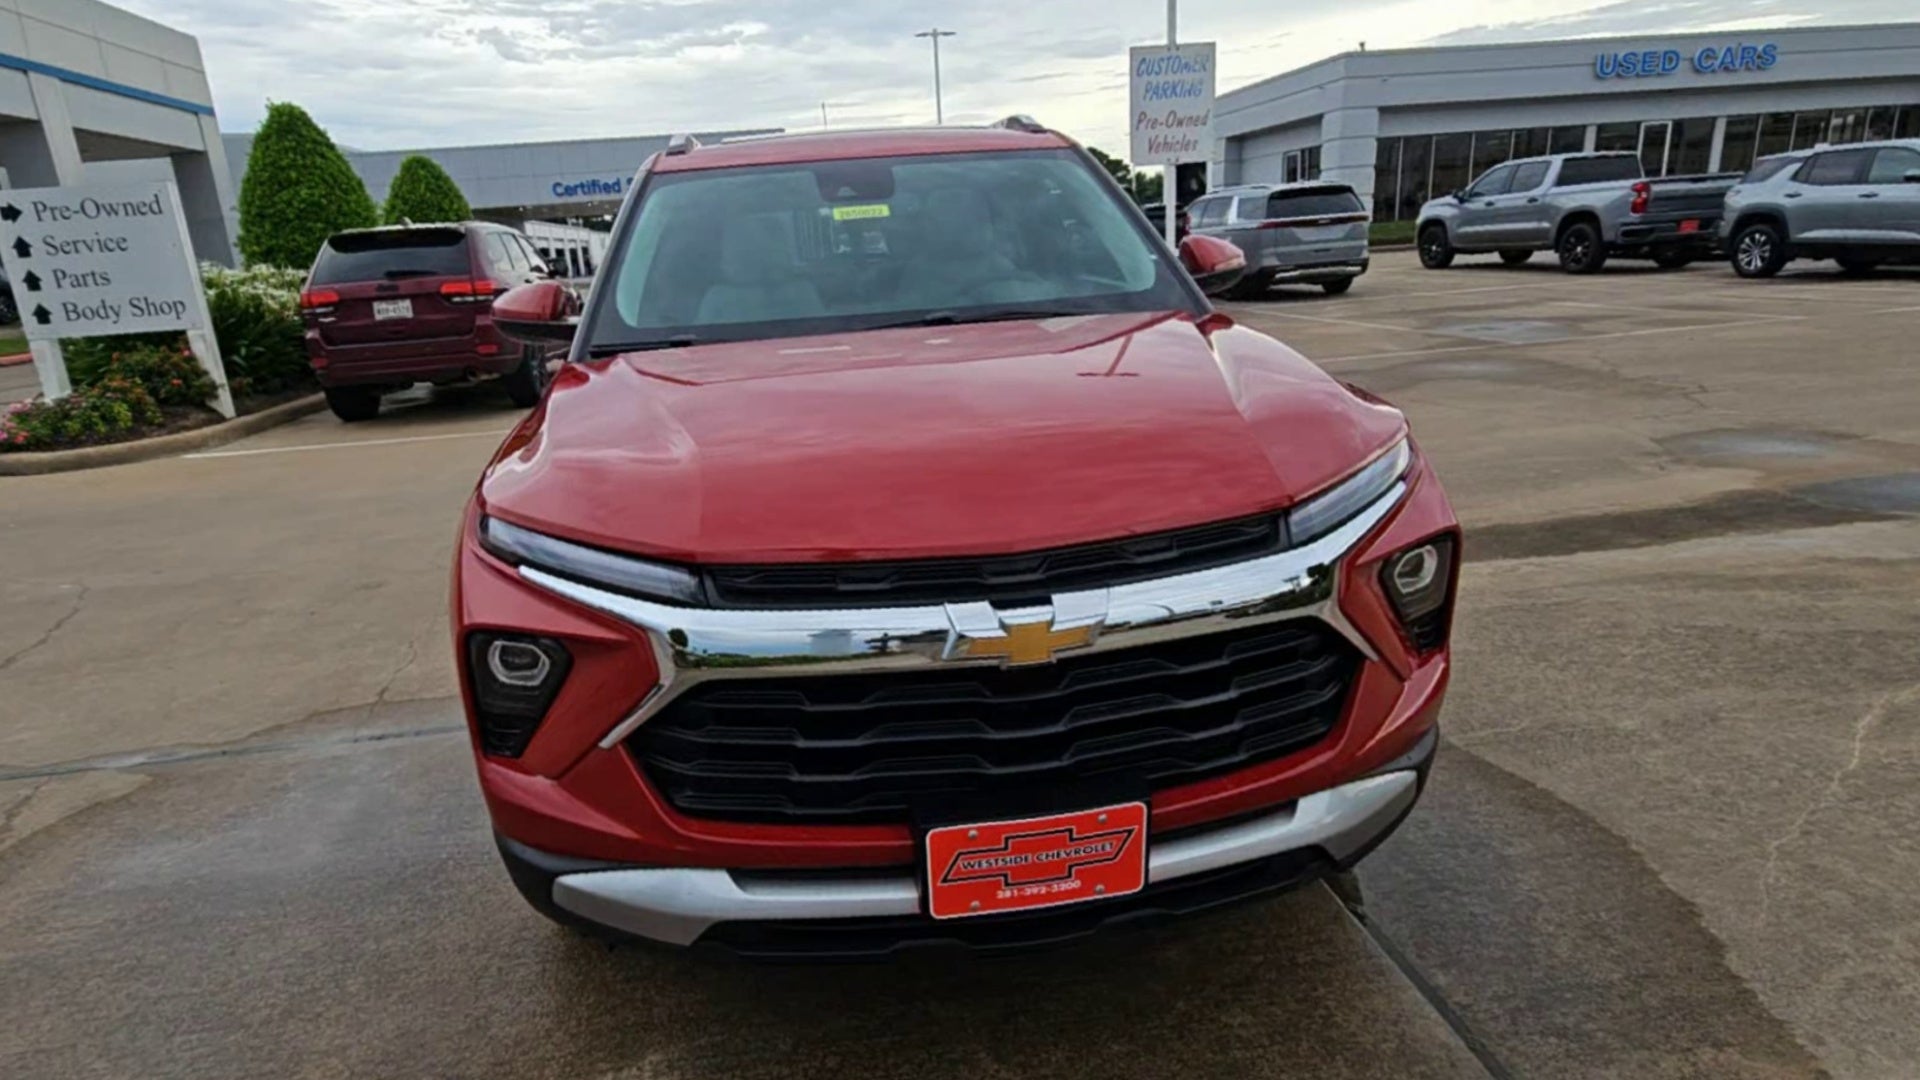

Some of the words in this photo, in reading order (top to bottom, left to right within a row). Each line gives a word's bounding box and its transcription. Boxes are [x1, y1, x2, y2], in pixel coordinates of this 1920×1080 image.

[1595, 49, 1681, 79] USED
[1694, 43, 1778, 73] CARS
[1135, 108, 1210, 131] Pre-Owned
[1147, 134, 1198, 154] Vehicles
[552, 177, 622, 197] Certified
[32, 193, 163, 222] Pre-Owned
[42, 231, 128, 256] Service
[52, 268, 112, 290] Parts
[61, 299, 122, 324] Body
[128, 296, 187, 320] Shop
[960, 853, 1032, 870] WESTSIDE
[1035, 841, 1115, 862] CHEVROLET
